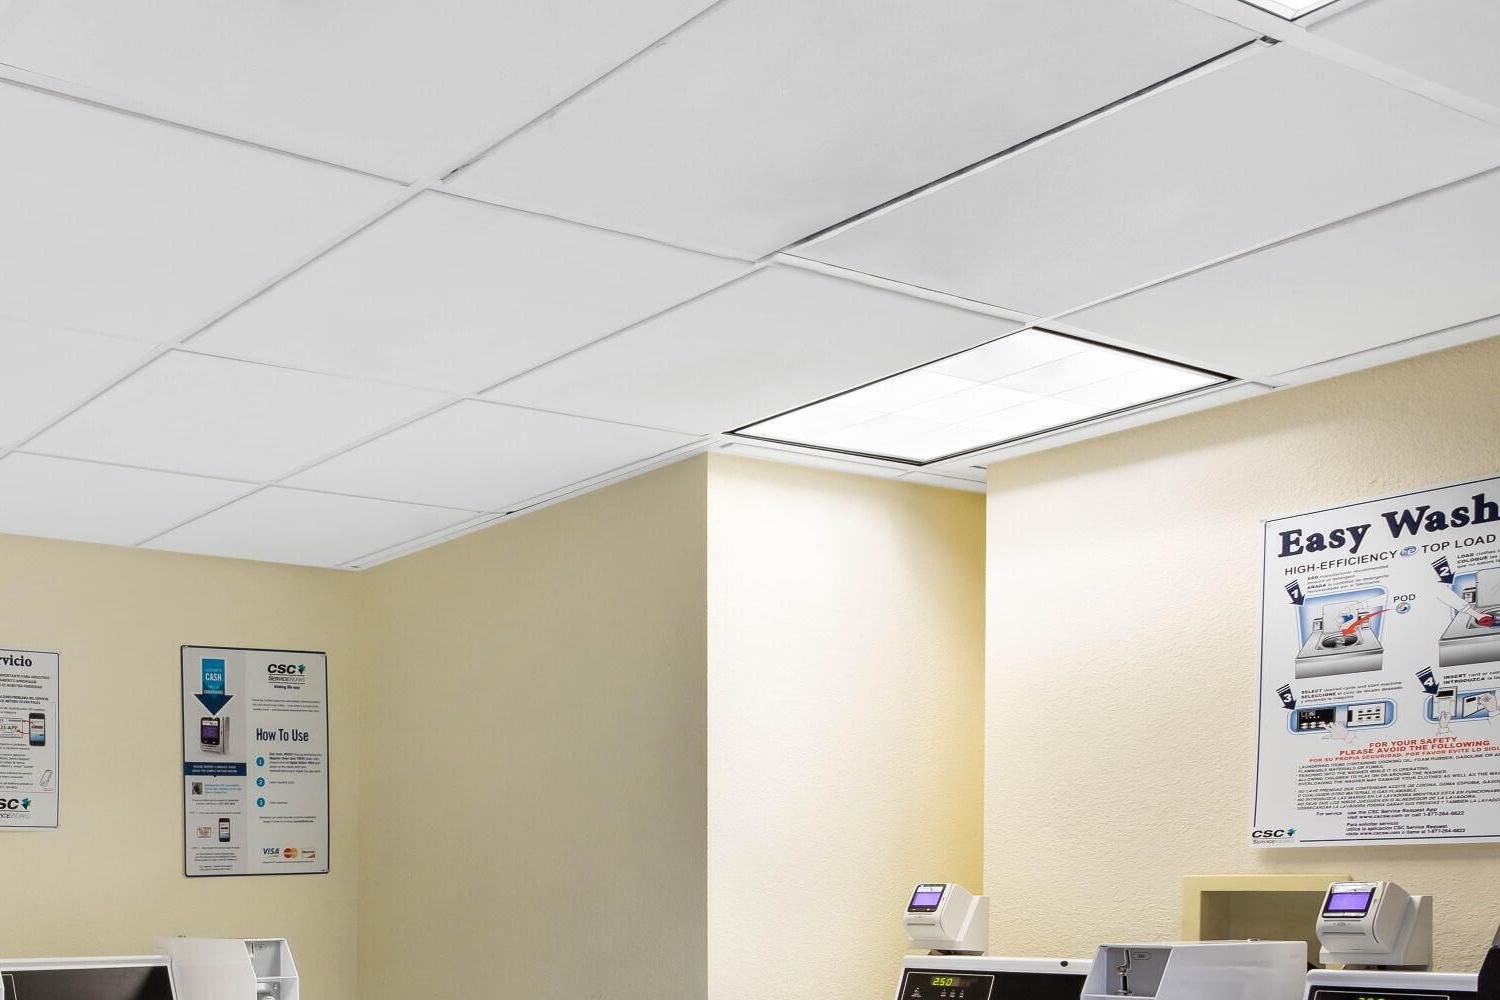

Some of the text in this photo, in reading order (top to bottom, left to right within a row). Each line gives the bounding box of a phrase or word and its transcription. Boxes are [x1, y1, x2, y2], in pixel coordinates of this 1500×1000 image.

[1278, 493, 1500, 557] Easy Wash
[1285, 534, 1497, 575] HIGH-EFFICIENCY TOP LOAD
[1440, 566, 1450, 576] 2
[1291, 589, 1299, 599] 1
[1393, 594, 1416, 603] POD
[268, 664, 296, 674] CSC
[206, 673, 221, 681] CASH
[1423, 677, 1434, 686] 4
[1283, 694, 1292, 703] 3
[256, 728, 308, 742] How To Use
[1431, 740, 1490, 749] FOLLOWING
[1252, 830, 1284, 838] CSC
